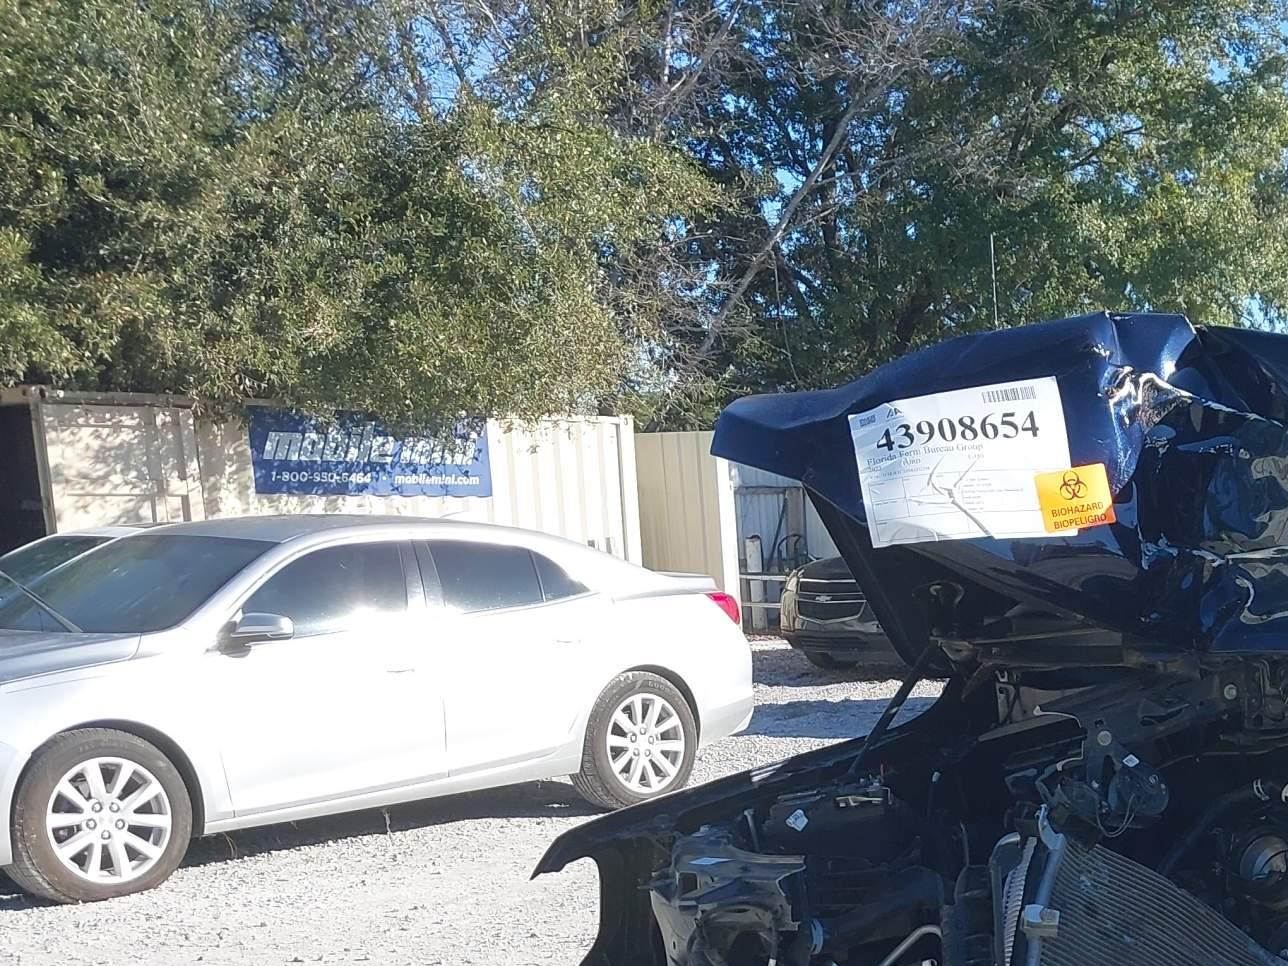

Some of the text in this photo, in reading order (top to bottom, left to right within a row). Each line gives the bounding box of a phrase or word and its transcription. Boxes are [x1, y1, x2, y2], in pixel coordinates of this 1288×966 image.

[876, 410, 1039, 452] 43908654
[263, 421, 394, 463] mobile
[867, 453, 897, 466] Florida
[271, 470, 480, 486] 1-800-950-6464 mobilemini.com
[1051, 502, 1104, 518] BIOHAZARD
[1053, 513, 1107, 529] BIOPELIGRO
